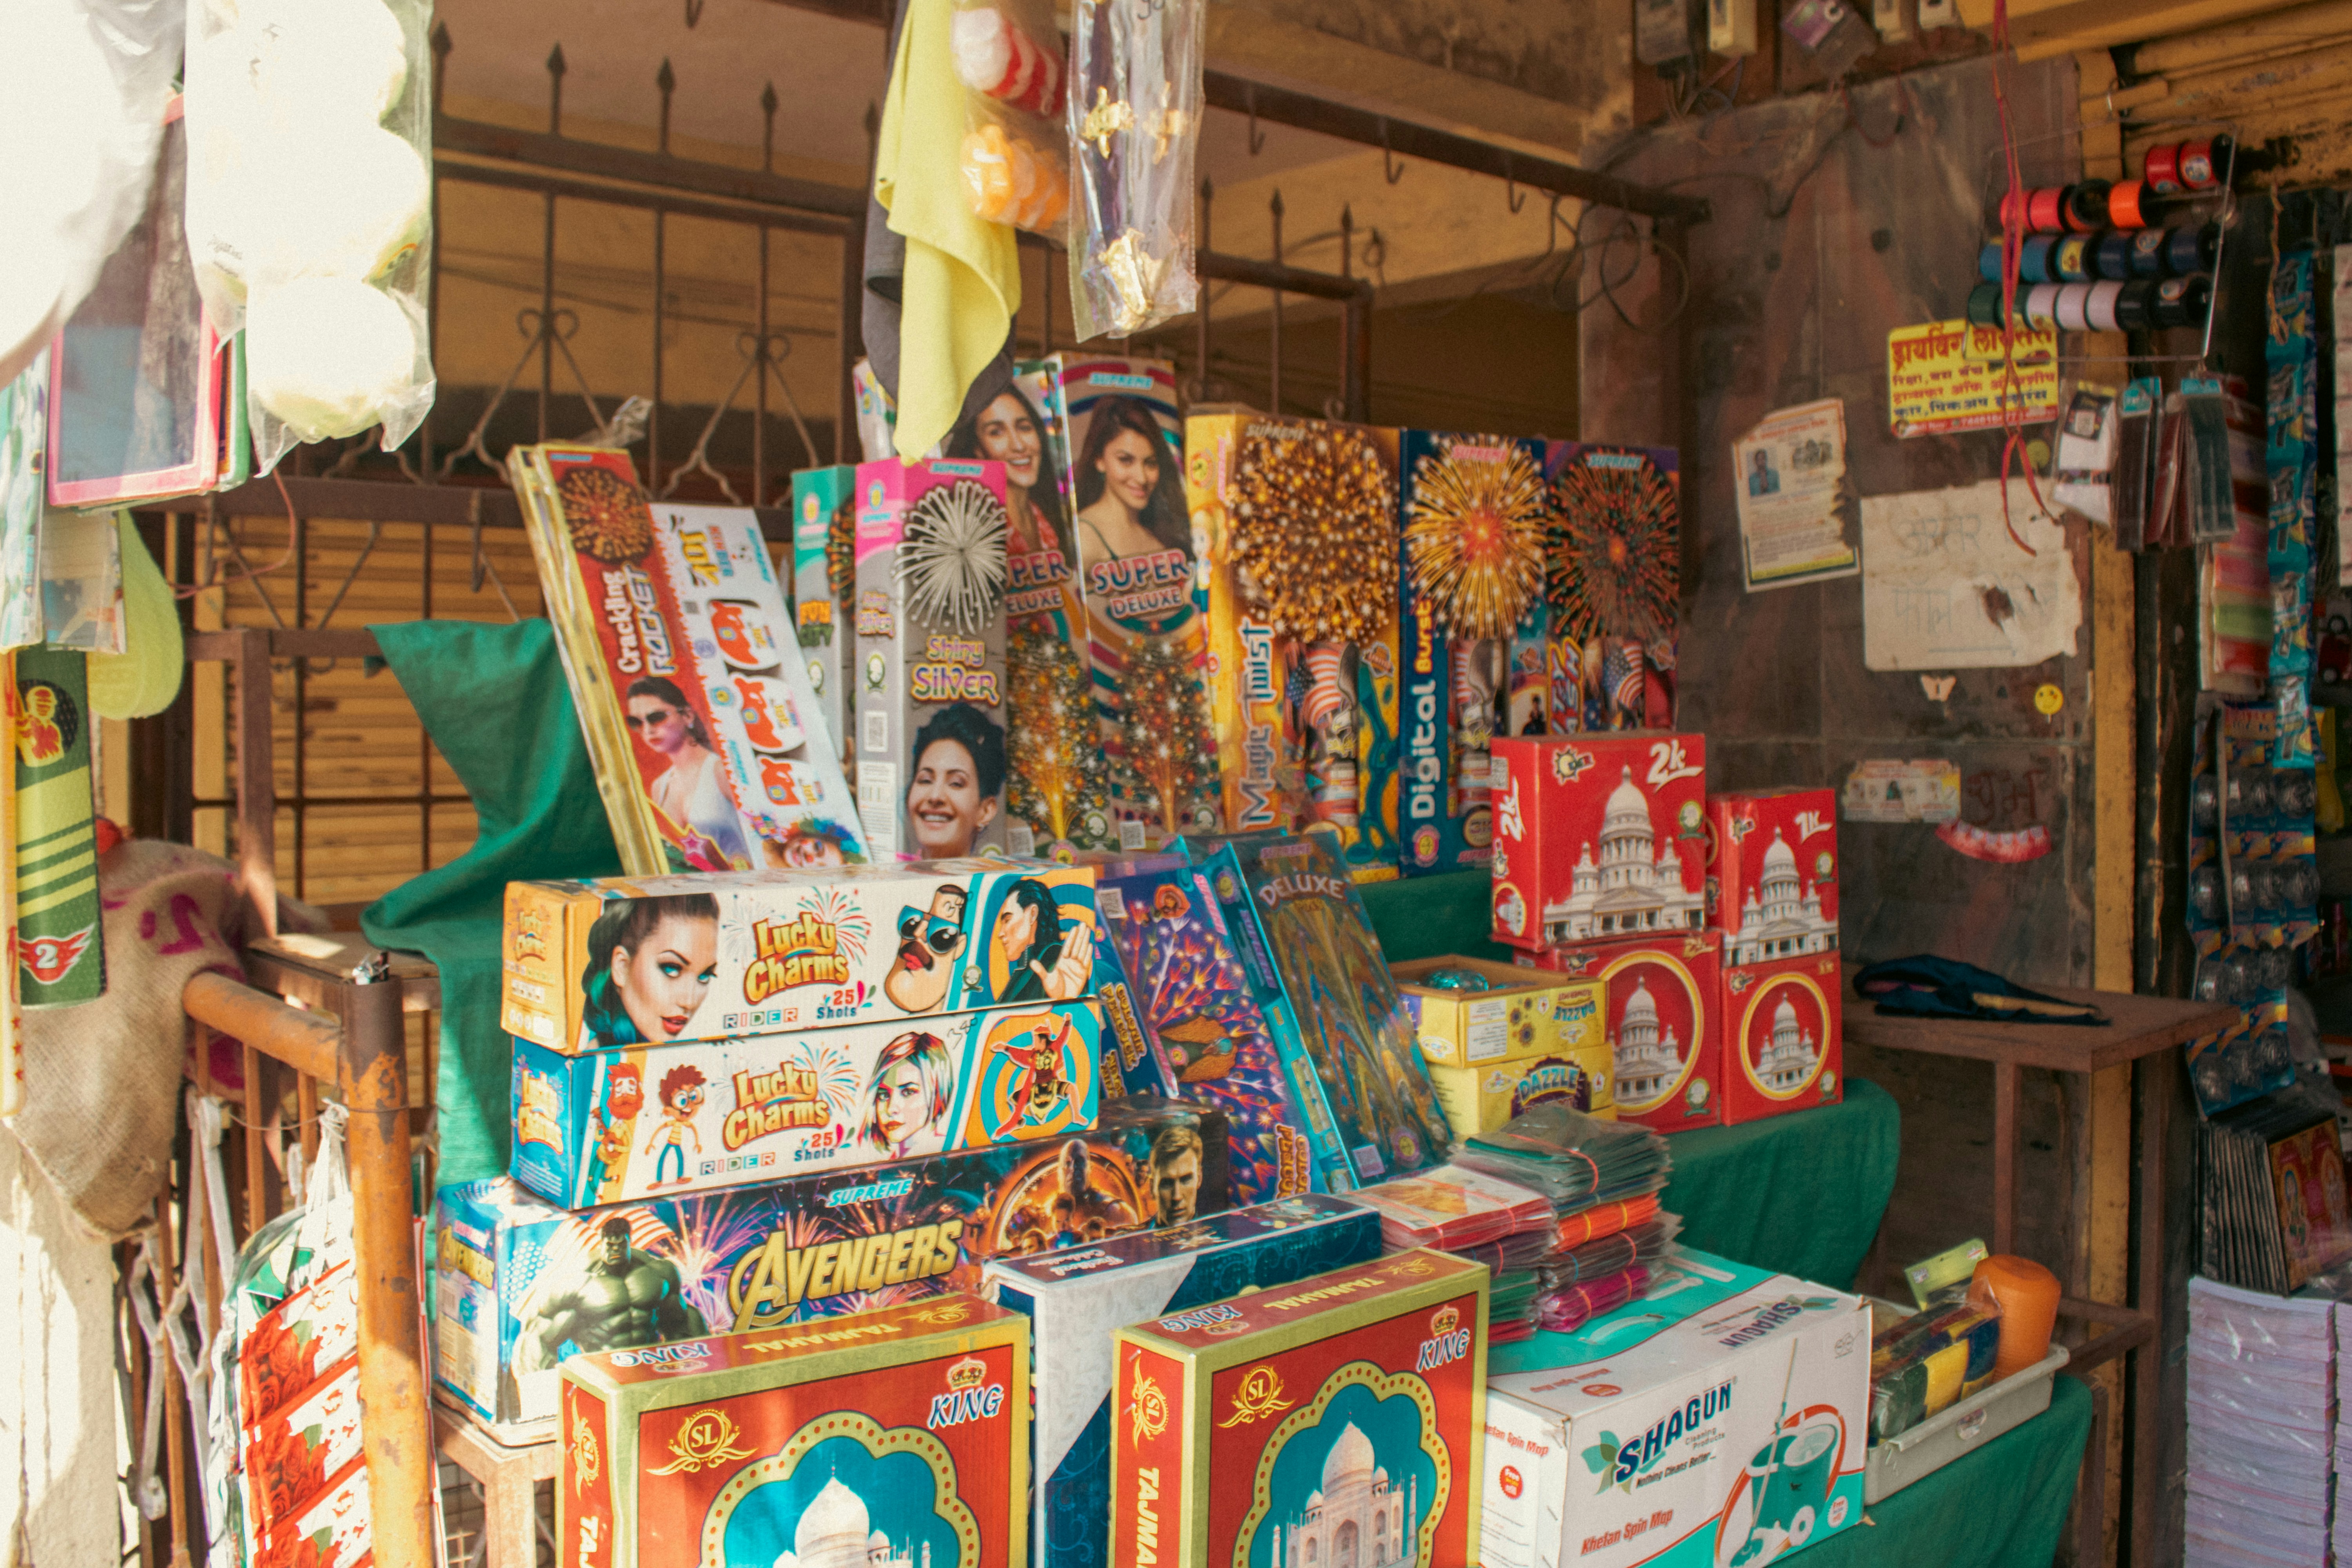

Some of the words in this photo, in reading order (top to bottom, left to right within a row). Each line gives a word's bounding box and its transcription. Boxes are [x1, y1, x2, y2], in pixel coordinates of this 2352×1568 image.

[1007, 549, 1072, 588] PER
[1092, 550, 1192, 593] SUPER
[1005, 588, 1063, 616] ELUXE
[1112, 586, 1183, 622] DELUXE
[602, 571, 642, 673] Crackling
[1414, 599, 1434, 673] Burst
[926, 635, 985, 666] Shiny
[1236, 616, 1277, 724] Twist
[1411, 679, 1440, 818] Digital
[1258, 874, 1345, 907] DELUXE
[752, 911, 838, 958] Lucky
[36, 943, 58, 969] 2
[744, 954, 849, 1006] Charms
[817, 1006, 857, 1019] Shots
[833, 989, 855, 1006] 25
[723, 1007, 798, 1030] RIDER
[733, 1061, 818, 1107] Lucky
[1518, 1066, 1581, 1104] DAZZLE
[722, 1100, 831, 1152] Charms
[811, 1131, 833, 1149] 25
[701, 1152, 776, 1176] RIDER
[794, 1147, 835, 1162] Shots
[826, 1179, 915, 1208] SUPREME
[729, 1218, 964, 1332] AVENGERS
[1263, 1276, 1387, 1310] TAJMAHAL
[1158, 1305, 1243, 1332] KING
[1720, 1301, 1803, 1350] SHAGUN
[742, 1322, 902, 1353] TAJMAHAL
[1416, 1327, 1470, 1373] KING
[611, 1342, 713, 1367] KING
[1247, 1379, 1268, 1401] SL
[927, 1383, 1005, 1430] KING
[1145, 1397, 1159, 1421] SL
[690, 1423, 719, 1448] SL
[1507, 1432, 1524, 1449] Spin
[1525, 1440, 1549, 1457] Mop
[1615, 1381, 1732, 1484] SHAGUN
[1685, 1427, 1717, 1446] Cleaning
[1692, 1432, 1725, 1450] Products
[1664, 1461, 1688, 1478] Cleans
[1580, 1525, 1622, 1557] Khetan
[1624, 1516, 1649, 1541] Spin
[1648, 1508, 1674, 1532] Mop
